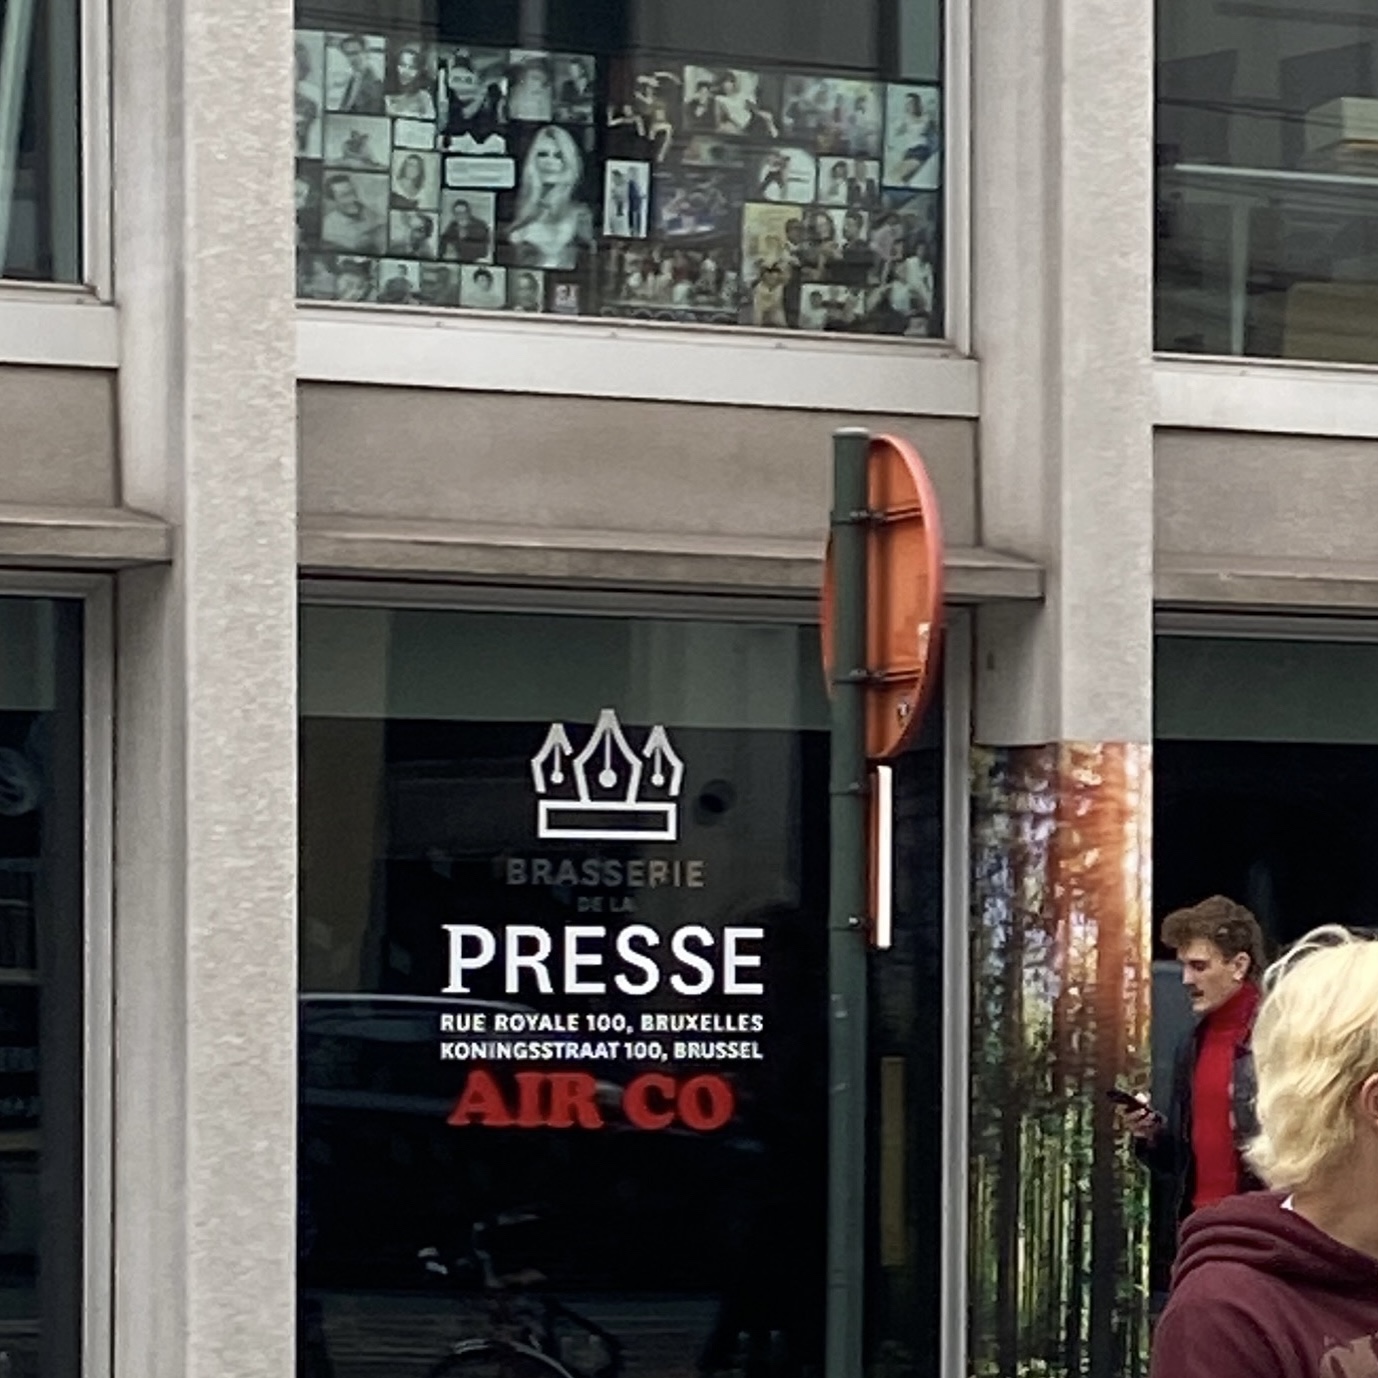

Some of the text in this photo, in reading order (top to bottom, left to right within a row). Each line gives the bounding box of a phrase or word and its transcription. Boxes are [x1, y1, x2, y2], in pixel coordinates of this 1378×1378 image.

[506, 858, 704, 887] BRASSERIE
[577, 896, 634, 912] DE LA
[441, 924, 764, 995] PRESSE
[440, 1013, 763, 1034] RUE ROYALE 100, BRUXELLES
[440, 1042, 763, 1062] KONINGSSTRAAT 100, BRUSSEL
[447, 1069, 734, 1130] AIR CO
